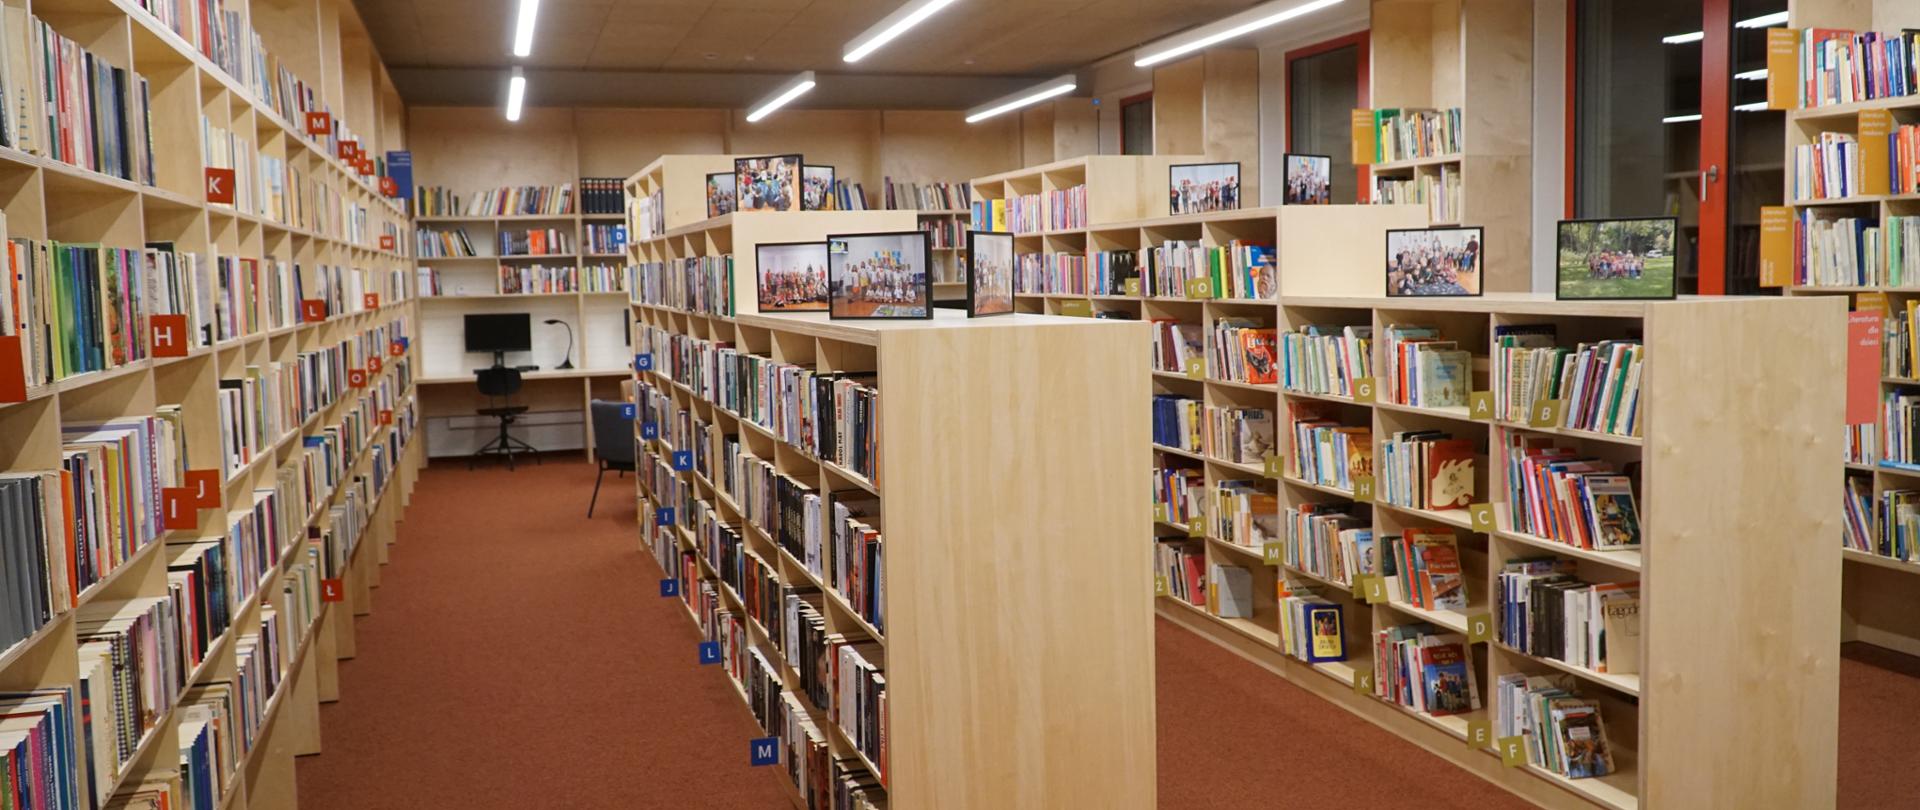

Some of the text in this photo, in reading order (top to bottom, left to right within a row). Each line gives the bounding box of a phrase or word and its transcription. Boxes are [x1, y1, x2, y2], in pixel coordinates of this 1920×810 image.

[312, 117, 325, 129] M
[343, 145, 353, 155] N
[208, 176, 221, 194] K
[616, 232, 623, 240] D
[1131, 282, 1138, 292] S
[1197, 282, 1207, 293] O
[367, 296, 374, 306] S
[309, 305, 317, 317] L
[154, 326, 172, 347] H
[639, 357, 648, 367] G
[1192, 363, 1200, 374] P
[351, 373, 362, 384] O
[1359, 384, 1371, 397] G
[625, 407, 631, 415] E
[1477, 399, 1487, 412] A
[1541, 406, 1551, 421] B
[646, 426, 654, 435] H
[680, 456, 687, 466] K
[1271, 462, 1278, 473] L
[196, 480, 205, 499] J
[1360, 483, 1370, 495] H
[171, 498, 177, 518] I
[1154, 506, 1160, 517] T
[664, 512, 668, 521] I
[1478, 510, 1489, 525] C
[1195, 522, 1201, 531] R
[1269, 548, 1279, 559] M
[667, 583, 673, 592] J
[1374, 584, 1380, 597] J
[1475, 621, 1485, 635] D
[707, 648, 714, 658] L
[1360, 676, 1368, 688] K
[1476, 728, 1484, 742] E
[758, 744, 771, 759] M
[1509, 744, 1517, 758] F
